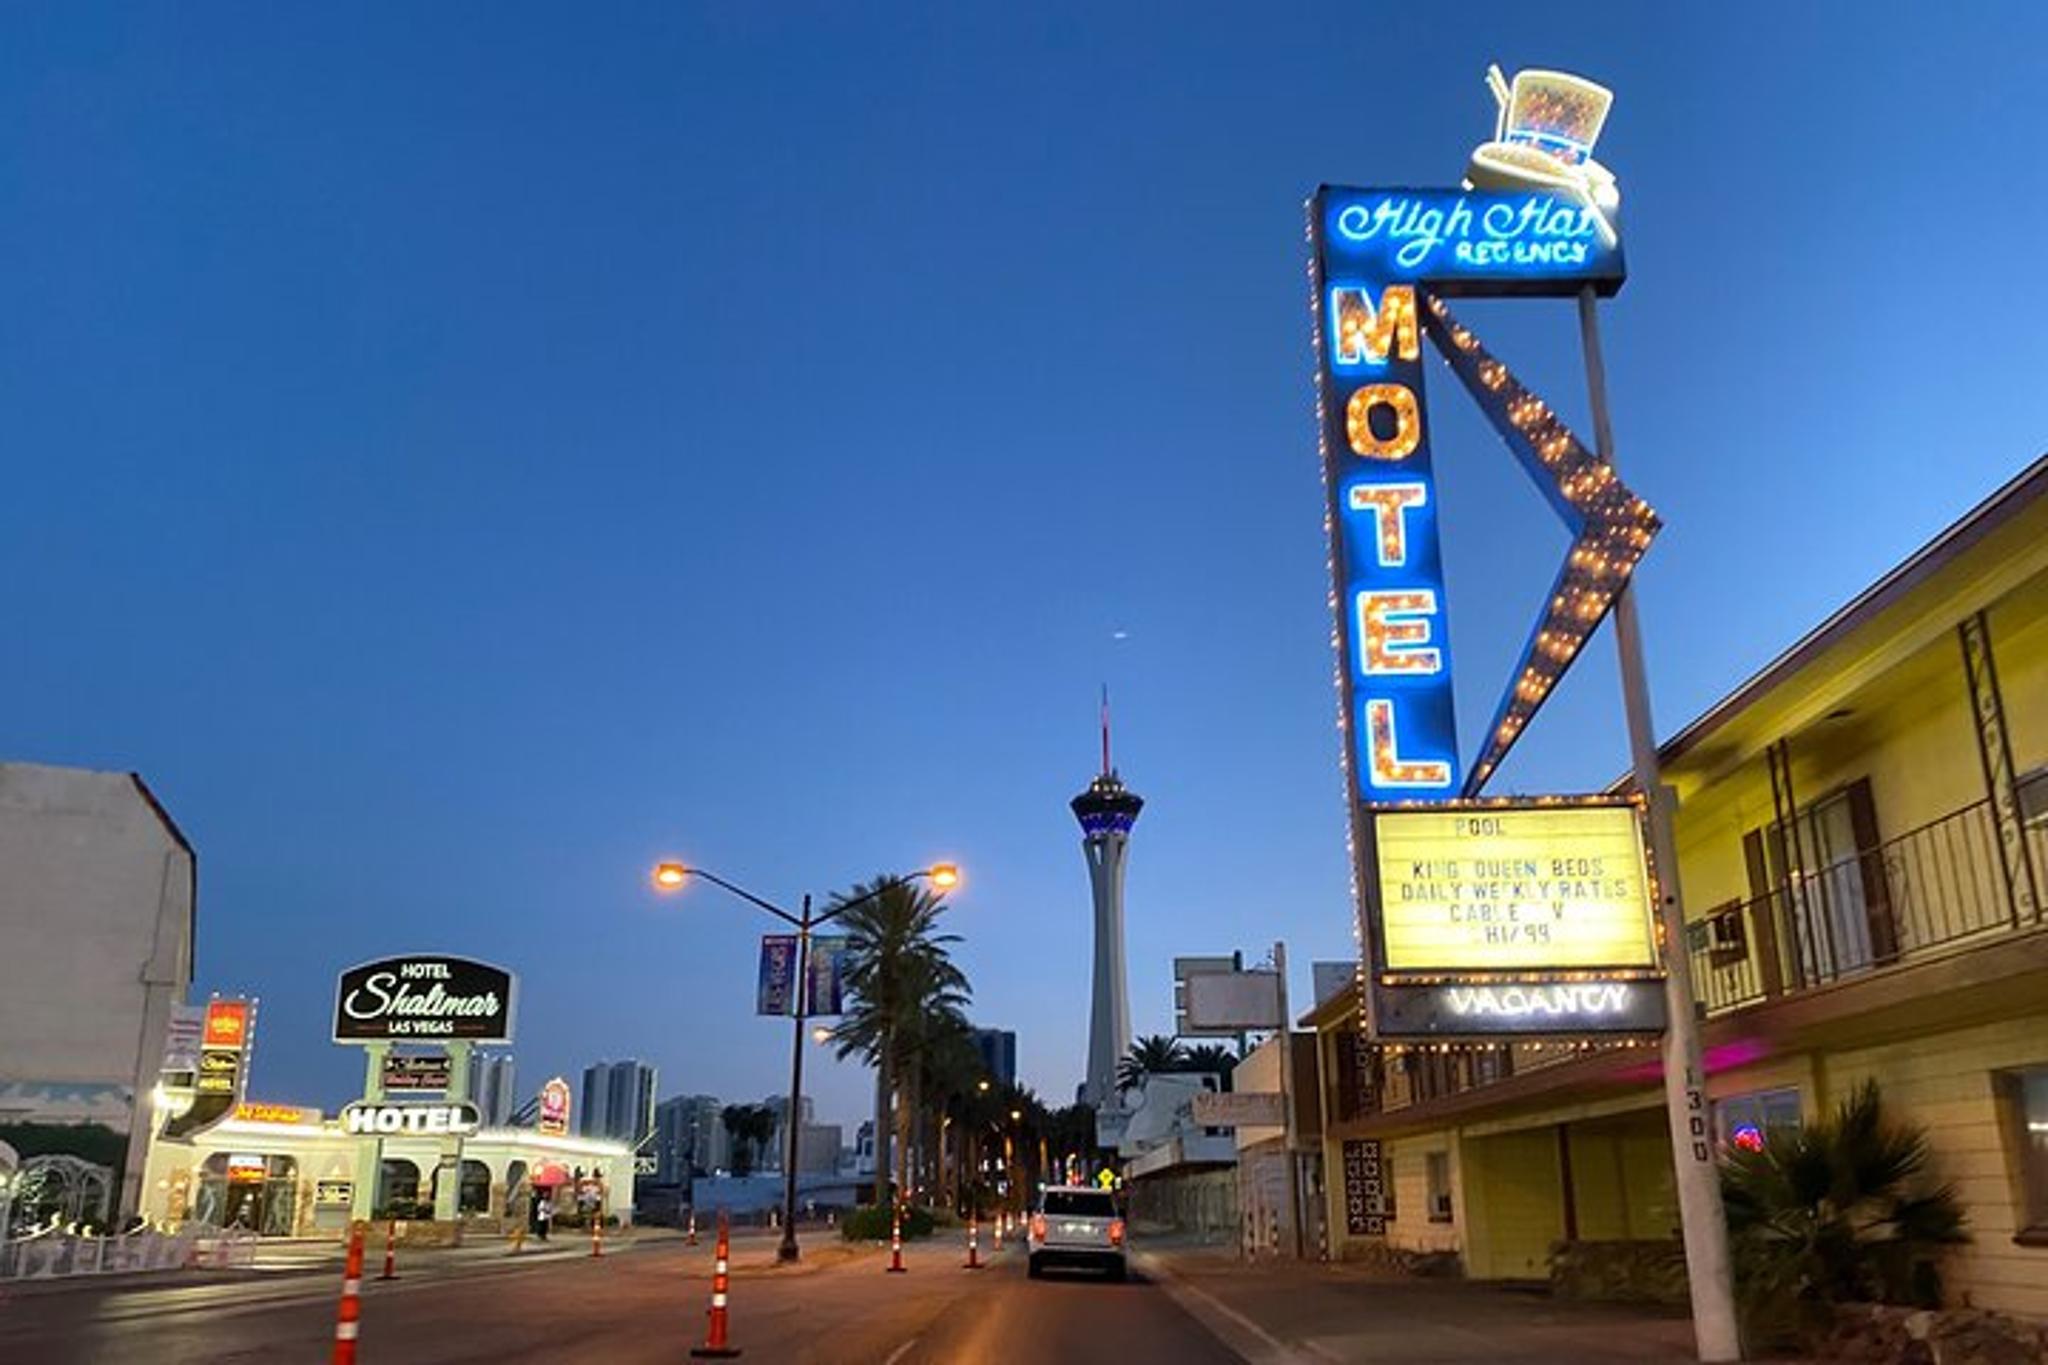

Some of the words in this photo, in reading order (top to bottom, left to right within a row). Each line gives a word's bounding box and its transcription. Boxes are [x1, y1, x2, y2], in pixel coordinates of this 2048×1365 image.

[1338, 197, 1473, 267] High
[1483, 197, 1596, 238] Hat
[1455, 241, 1588, 264] REGENCY
[1332, 283, 1451, 789] MOTEL
[1455, 817, 1507, 837] POOL
[1551, 858, 1604, 877] BEDS
[1401, 882, 1463, 901] DAILY
[399, 963, 452, 979] HOTEL
[344, 971, 500, 1020] Shalimar
[1447, 983, 1629, 1015] VACANCY
[387, 1021, 411, 1034] LAS
[412, 1020, 454, 1034] VEGAS
[348, 1106, 473, 1133] HOTEL
